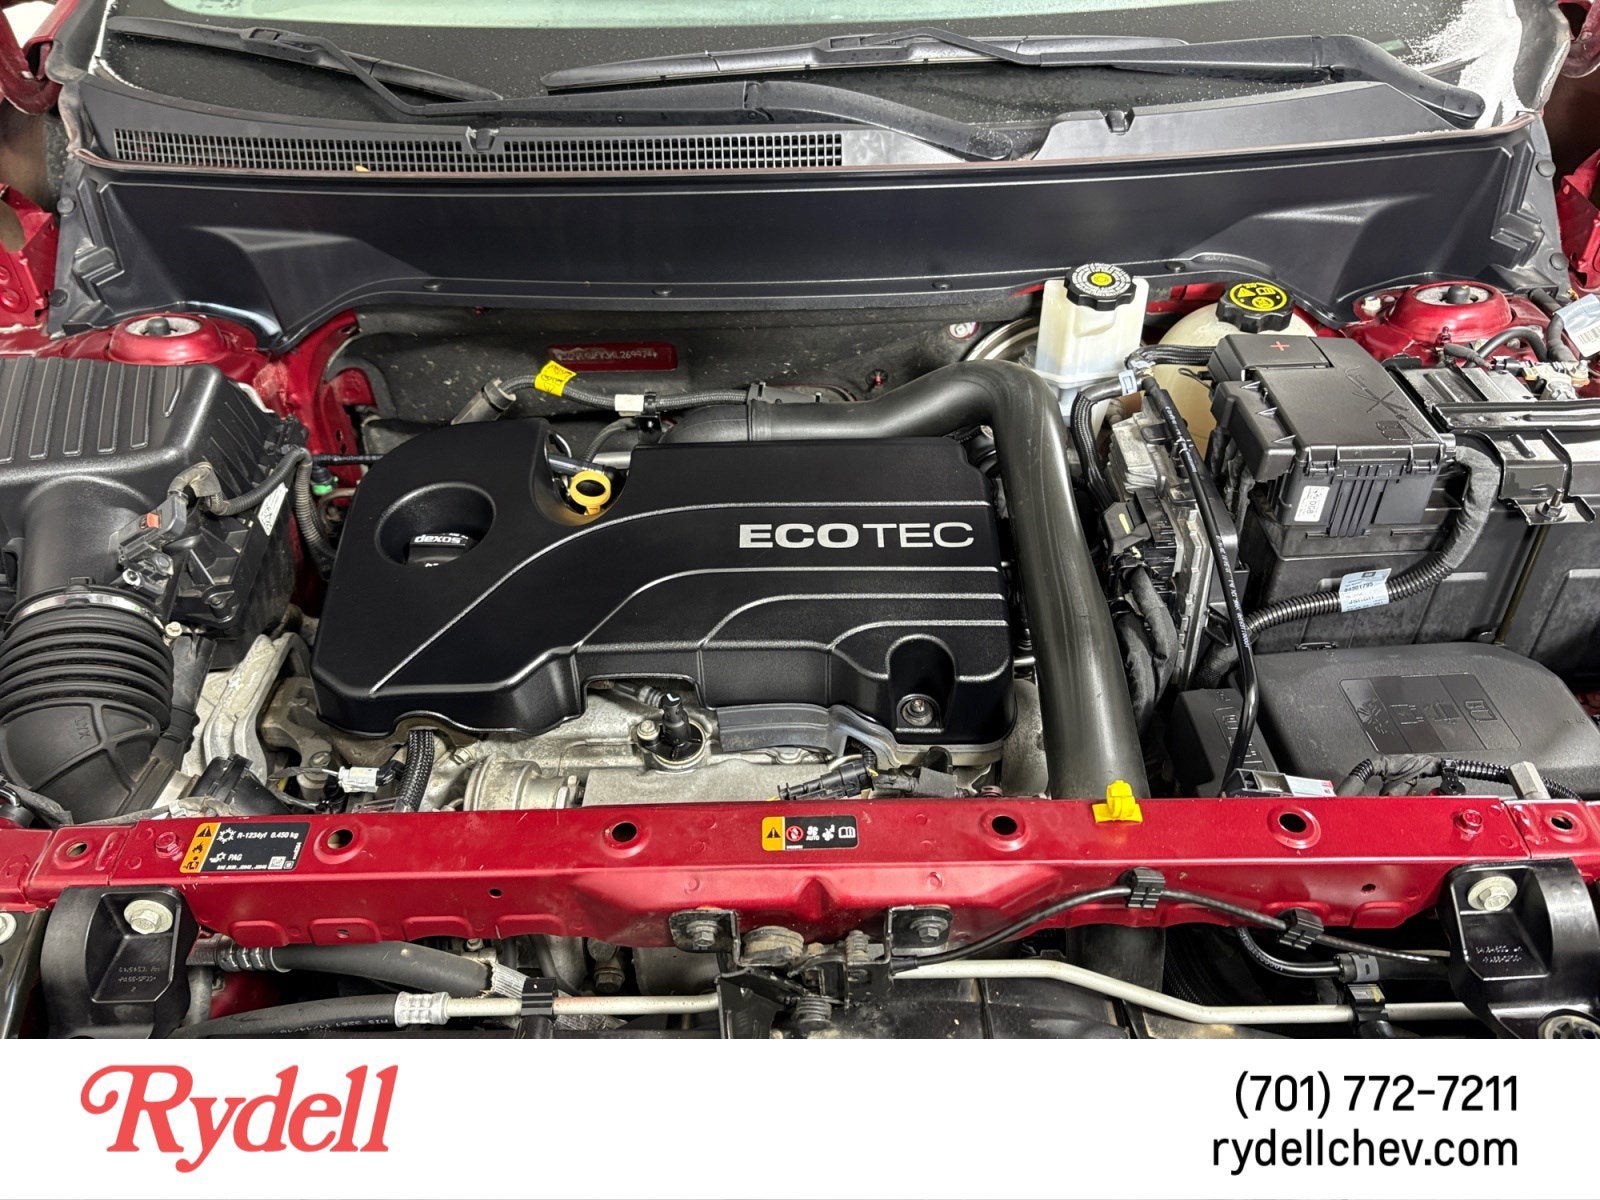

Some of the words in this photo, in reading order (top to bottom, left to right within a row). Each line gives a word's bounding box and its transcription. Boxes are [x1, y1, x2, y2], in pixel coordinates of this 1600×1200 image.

[414, 534, 461, 544] dexos
[739, 522, 975, 549] ECOTEC
[236, 831, 268, 840] R-1234yf
[270, 831, 289, 839] 0.450
[289, 831, 300, 840] kg
[227, 853, 243, 861] PAG
